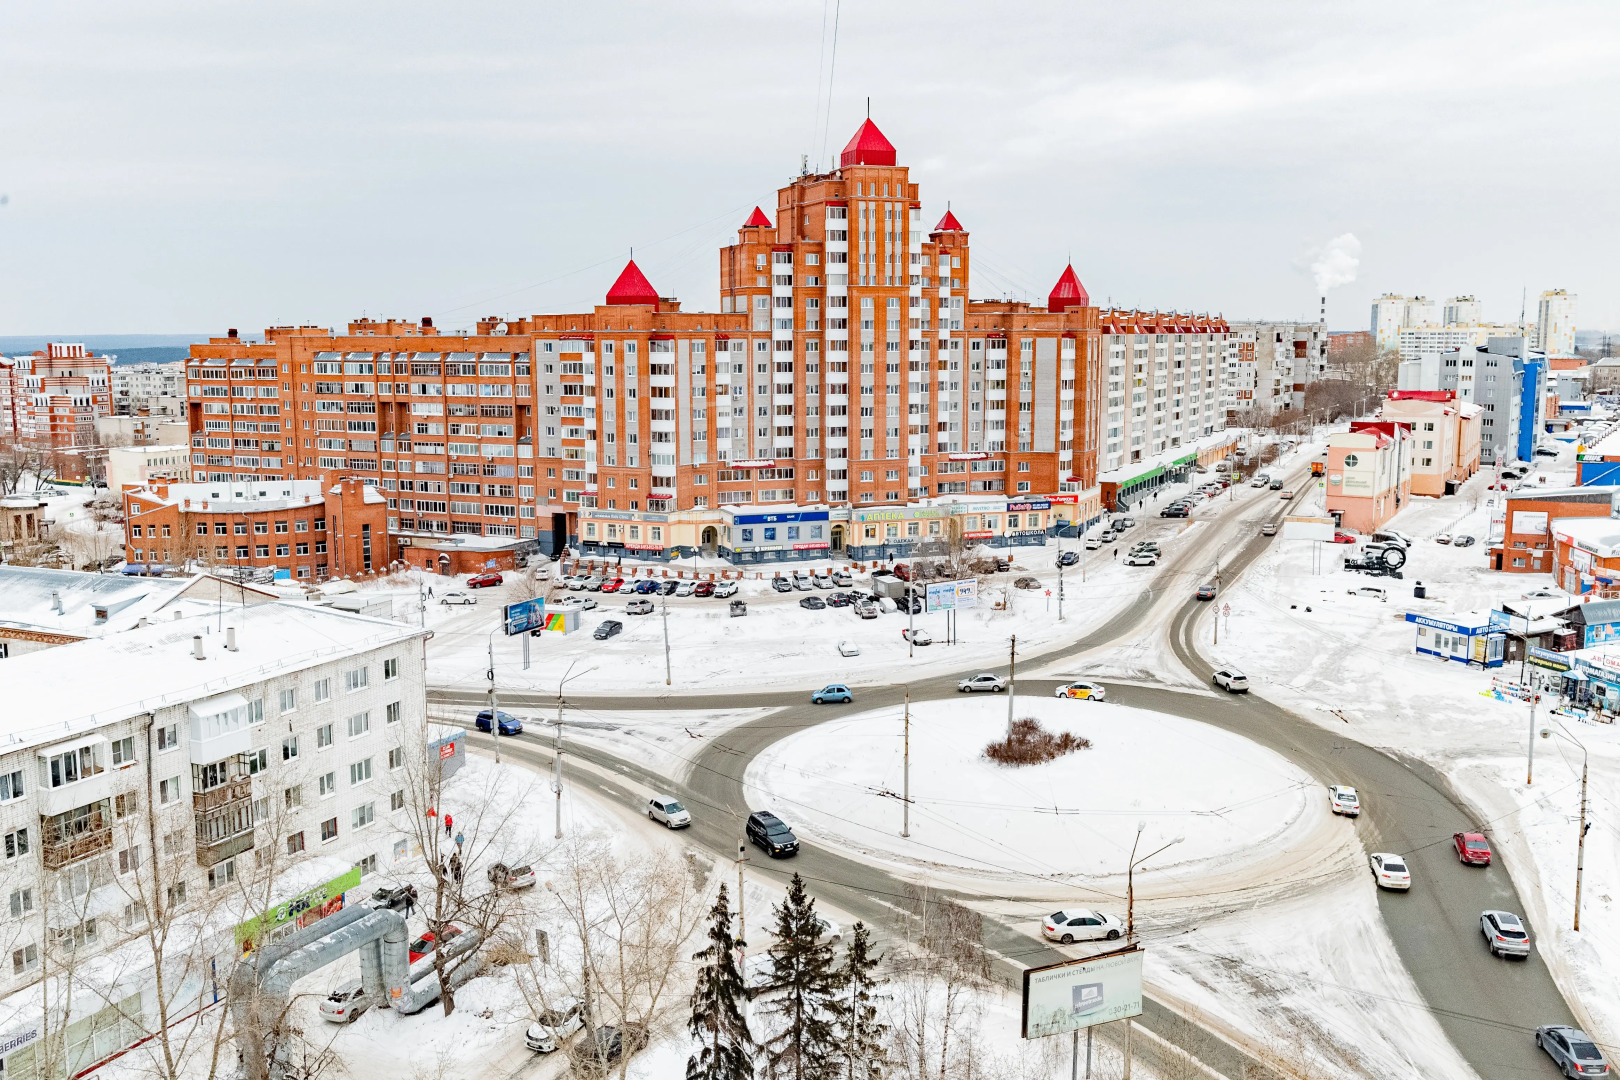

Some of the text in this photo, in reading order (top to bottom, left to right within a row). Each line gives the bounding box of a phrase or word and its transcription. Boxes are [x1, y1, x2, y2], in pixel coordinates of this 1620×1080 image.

[866, 512, 904, 521] АПТЕКА
[1415, 617, 1458, 632] АККУМУЛЯТОРЫ
[1035, 972, 1066, 984] ТАБЛИЧКИ
[1066, 970, 1071, 978] И
[1072, 967, 1096, 976] СТЕНДЫ
[1113, 1001, 1140, 1013] 30-21-71
